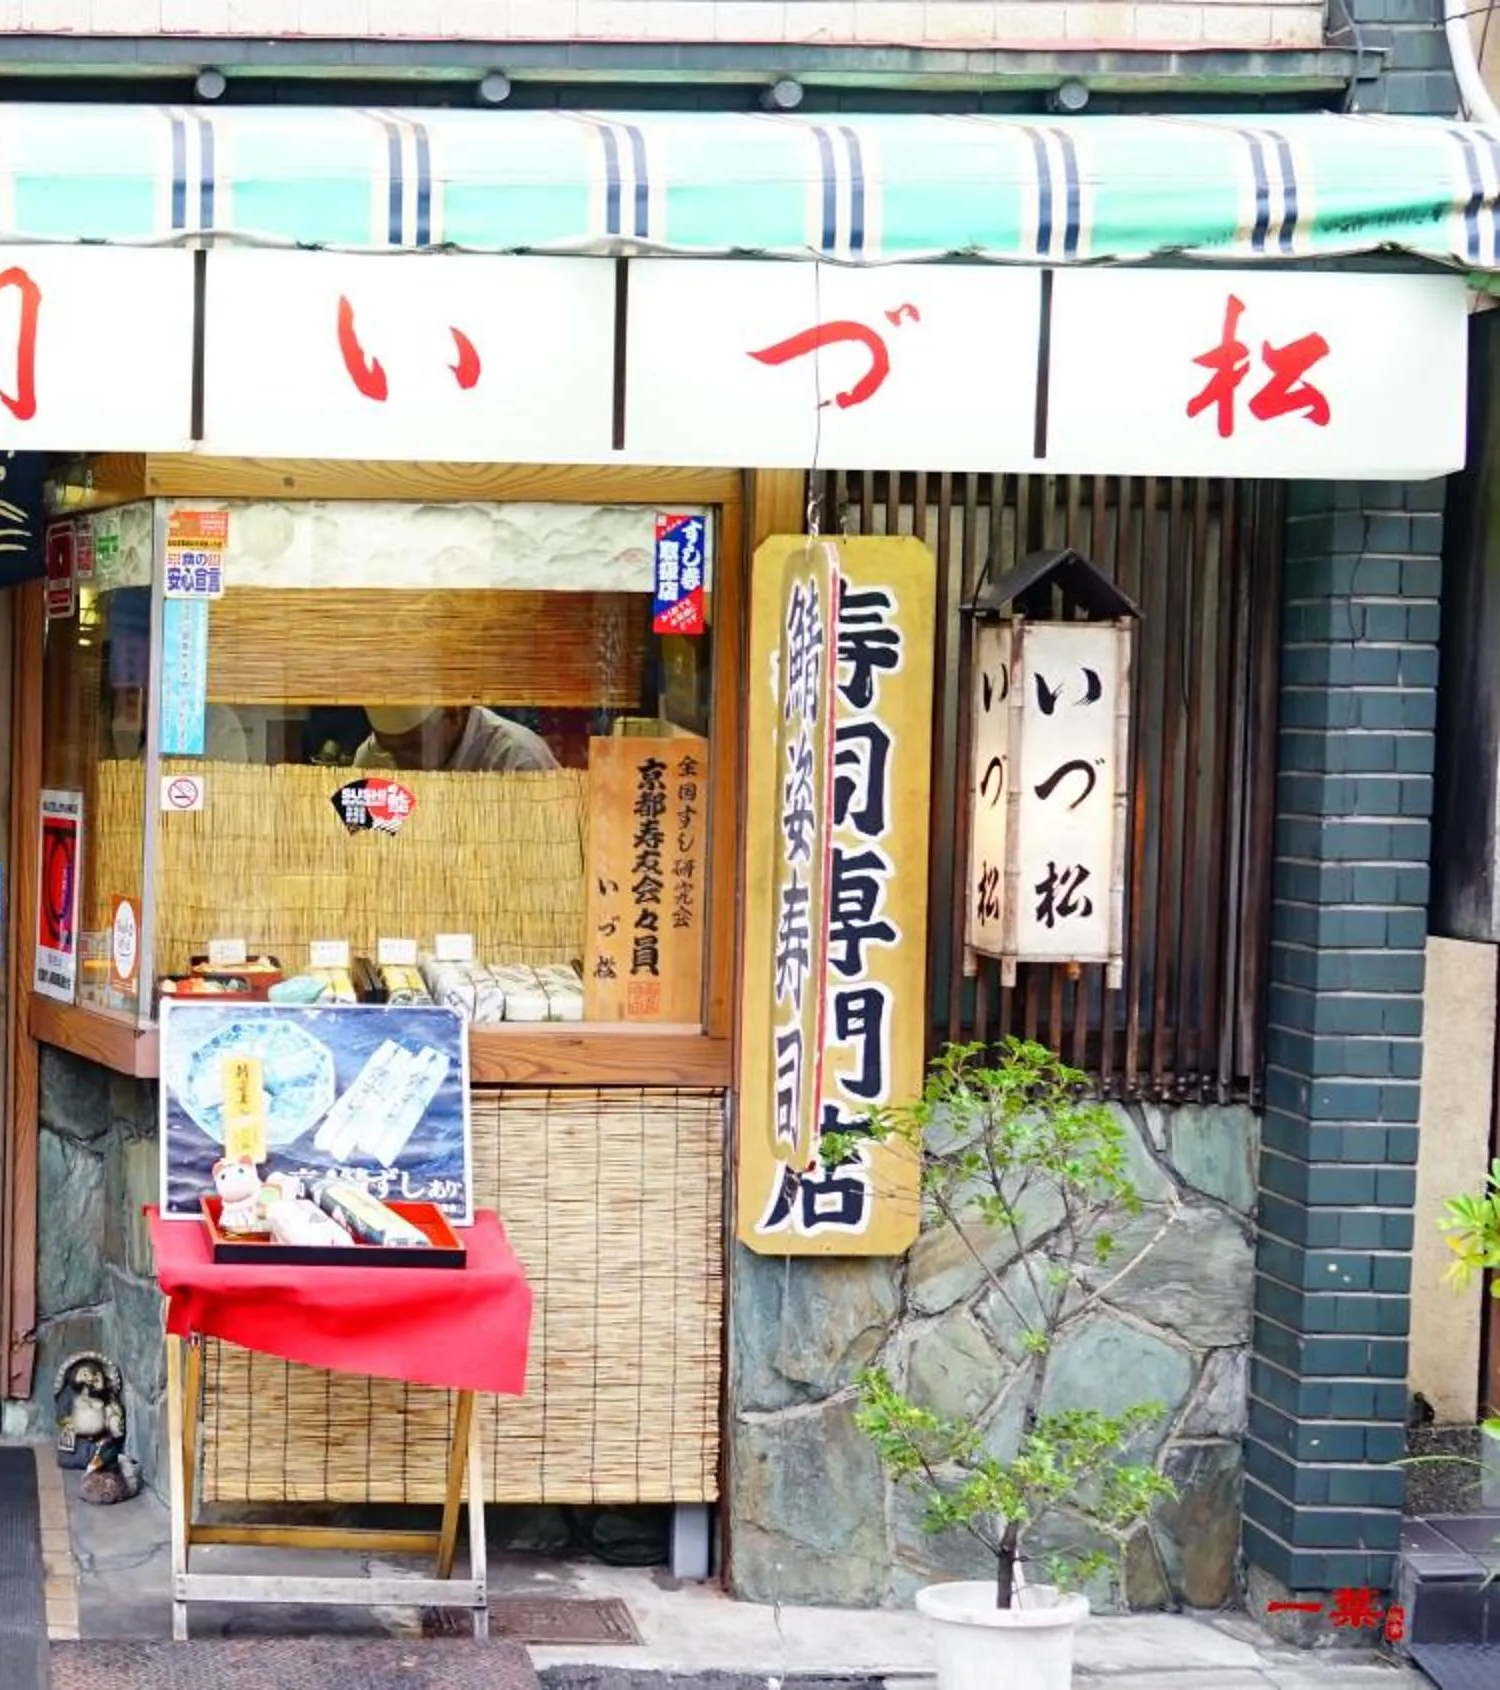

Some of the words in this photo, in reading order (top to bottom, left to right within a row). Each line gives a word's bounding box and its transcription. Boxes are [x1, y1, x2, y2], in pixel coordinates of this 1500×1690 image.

[167, 567, 221, 593] 安心宣言
[341, 787, 387, 801] SUSHI
[977, 662, 1008, 929] いづ松
[1034, 664, 1106, 931] いづ松
